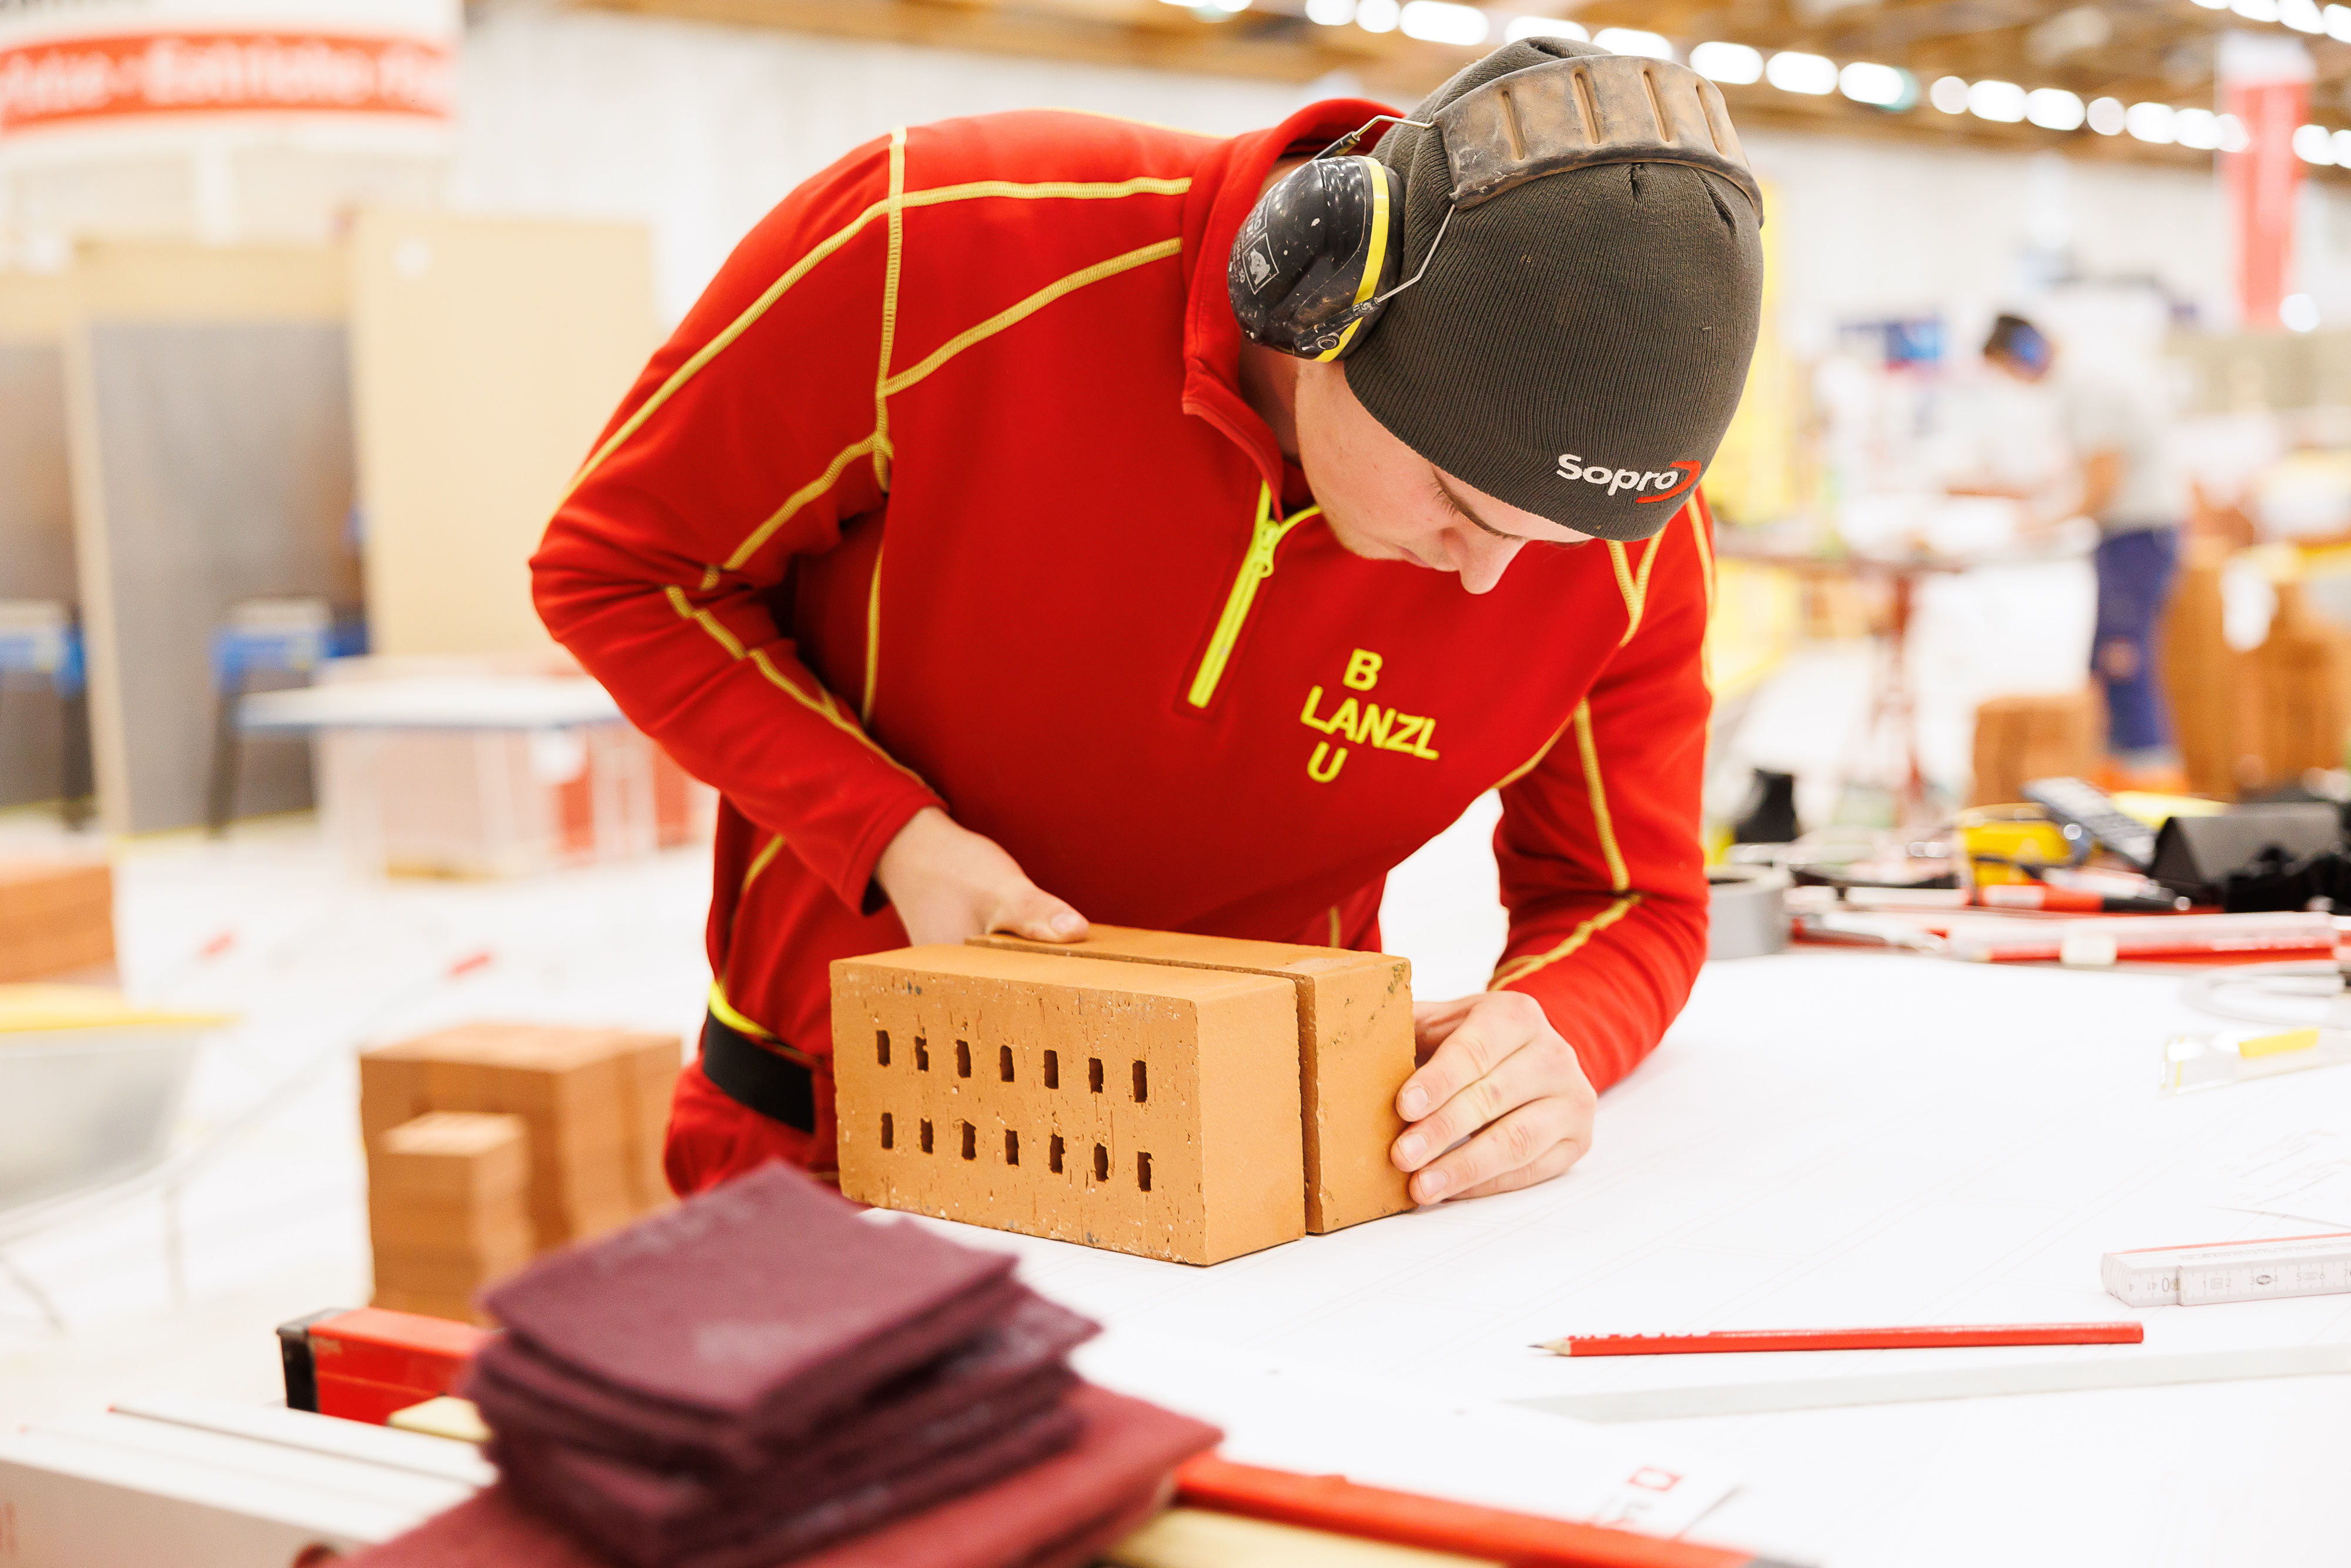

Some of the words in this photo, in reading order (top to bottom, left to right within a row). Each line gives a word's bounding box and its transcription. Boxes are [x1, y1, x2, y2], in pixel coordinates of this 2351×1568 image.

[1556, 454, 1679, 496] Sopro
[1342, 648, 1384, 692] B
[1300, 685, 1440, 760] LANZL
[1307, 740, 1349, 783] U
[2225, 1278, 2232, 1287] 2
[2249, 1275, 2255, 1285] 3
[2296, 1272, 2302, 1282] 5
[2319, 1271, 2326, 1280] 6
[2343, 1268, 2349, 1278] 7
